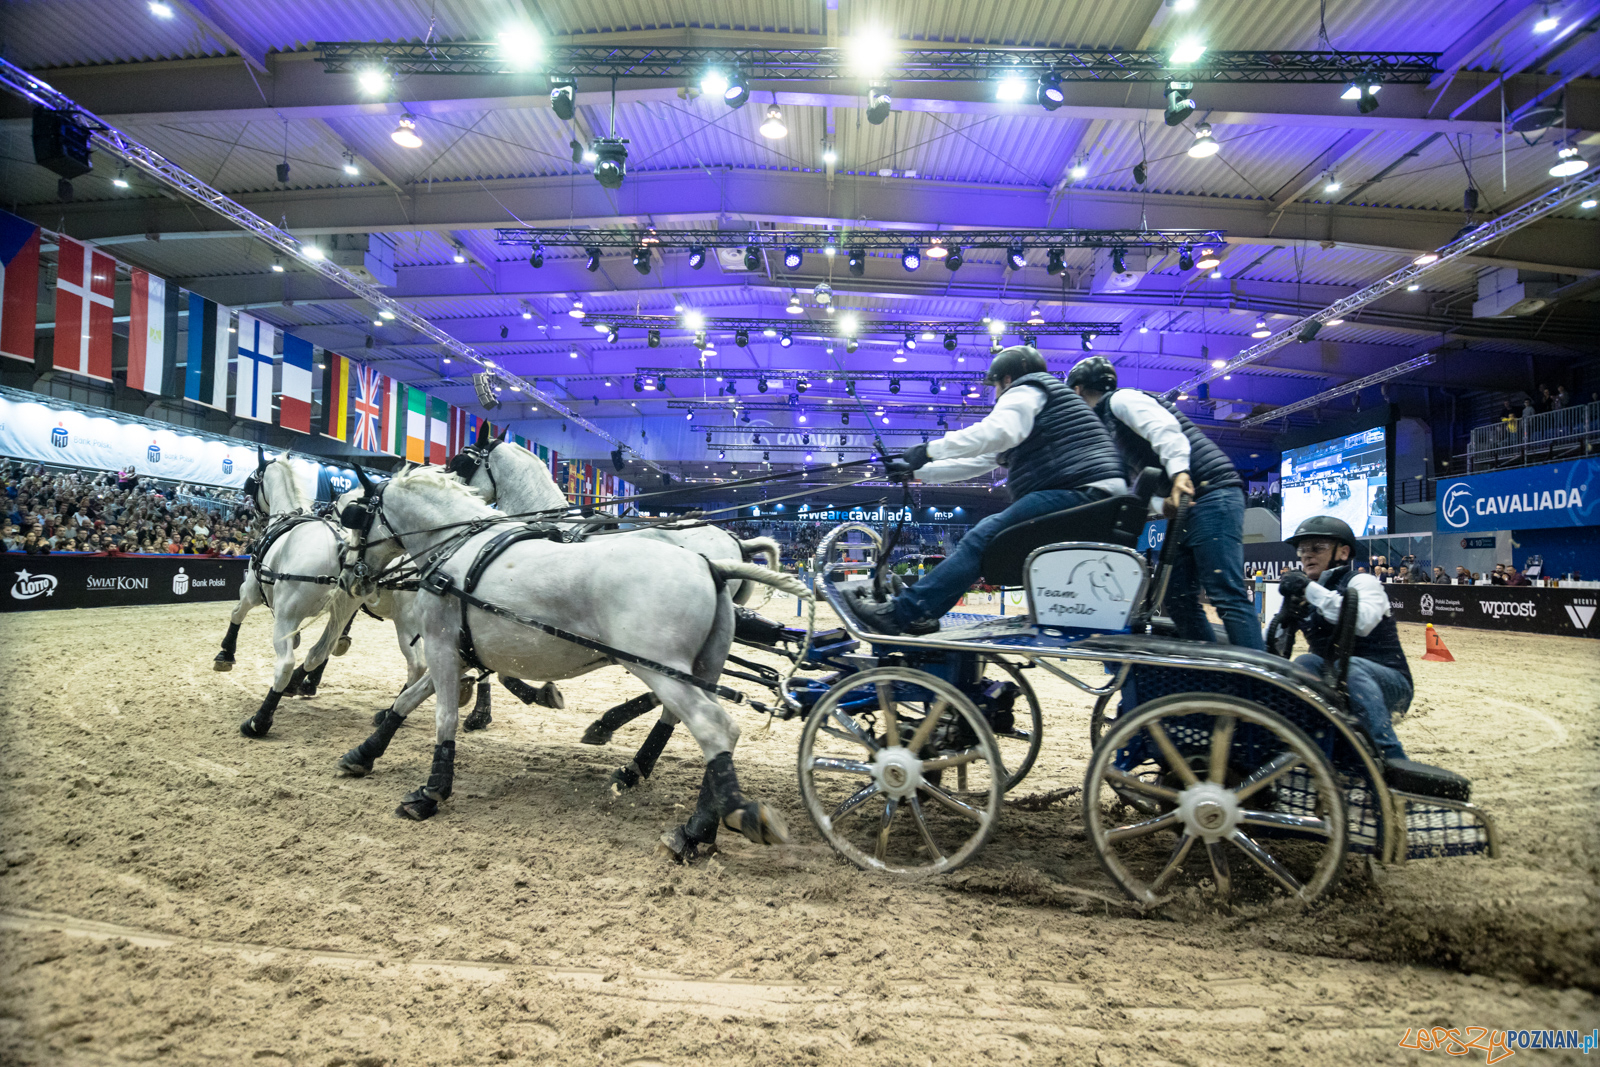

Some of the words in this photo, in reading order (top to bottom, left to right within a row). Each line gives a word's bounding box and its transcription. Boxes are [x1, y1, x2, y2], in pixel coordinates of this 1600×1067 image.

[73, 436, 91, 446] Bank
[93, 439, 112, 449] Polski
[331, 476, 352, 490] mtp
[1476, 488, 1583, 516] CAVALIADA
[798, 507, 912, 521] #wearecavalada
[934, 511, 954, 519] mtp
[20, 579, 49, 595] LOTTO
[192, 579, 208, 587] Bank
[208, 578, 226, 587] Polski
[1036, 586, 1079, 599] Team
[1048, 603, 1098, 617] Apollo
[1479, 600, 1537, 618] wprost
[1432, 634, 1439, 646] 7
